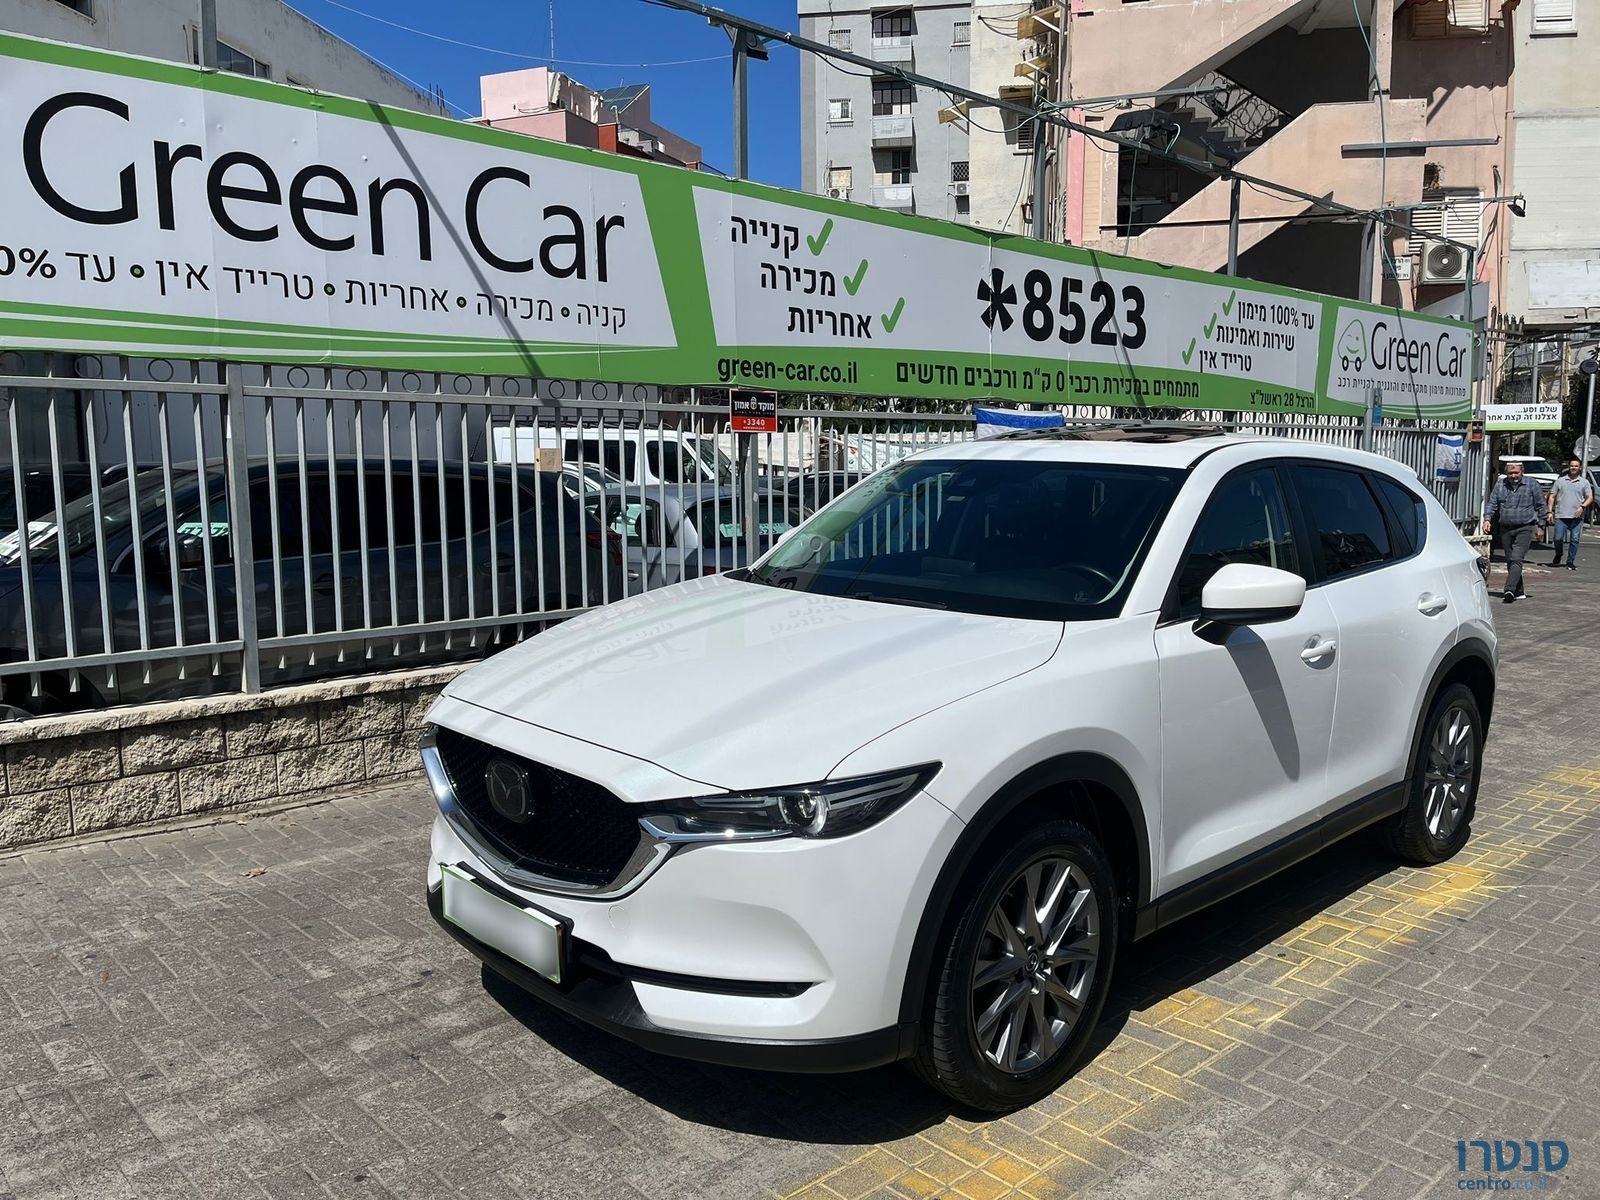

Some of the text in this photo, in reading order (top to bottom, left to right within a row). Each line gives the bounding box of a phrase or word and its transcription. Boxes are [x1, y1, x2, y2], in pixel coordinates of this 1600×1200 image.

[22, 92, 624, 282] Green Car
[731, 215, 799, 260] קנייה
[65, 252, 115, 282] עד
[155, 260, 210, 296] אין
[760, 262, 836, 297] מכירה
[223, 266, 314, 300] טרייד
[345, 280, 449, 312] אחריות
[477, 293, 553, 321] מכירה
[578, 303, 626, 334] קניה
[1238, 301, 1315, 330] עד 100% מימון
[787, 305, 872, 339] אחריות
[1216, 325, 1295, 352] שירות ואמינות
[1370, 322, 1466, 378] Green Car
[717, 356, 859, 385] green-car.co.il
[896, 362, 958, 386] חדשים
[1199, 350, 1252, 373] טרייד אין
[965, 367, 1017, 388] ורכבים
[1056, 370, 1065, 392] 0
[1069, 375, 1099, 394] רכבי
[1103, 377, 1150, 395] במכירת
[1153, 379, 1199, 398] מתמחים
[757, 402, 774, 412] מוקד
[1284, 392, 1294, 407] 28
[1295, 392, 1315, 409] הרצל
[1504, 414, 1522, 422] קצת
